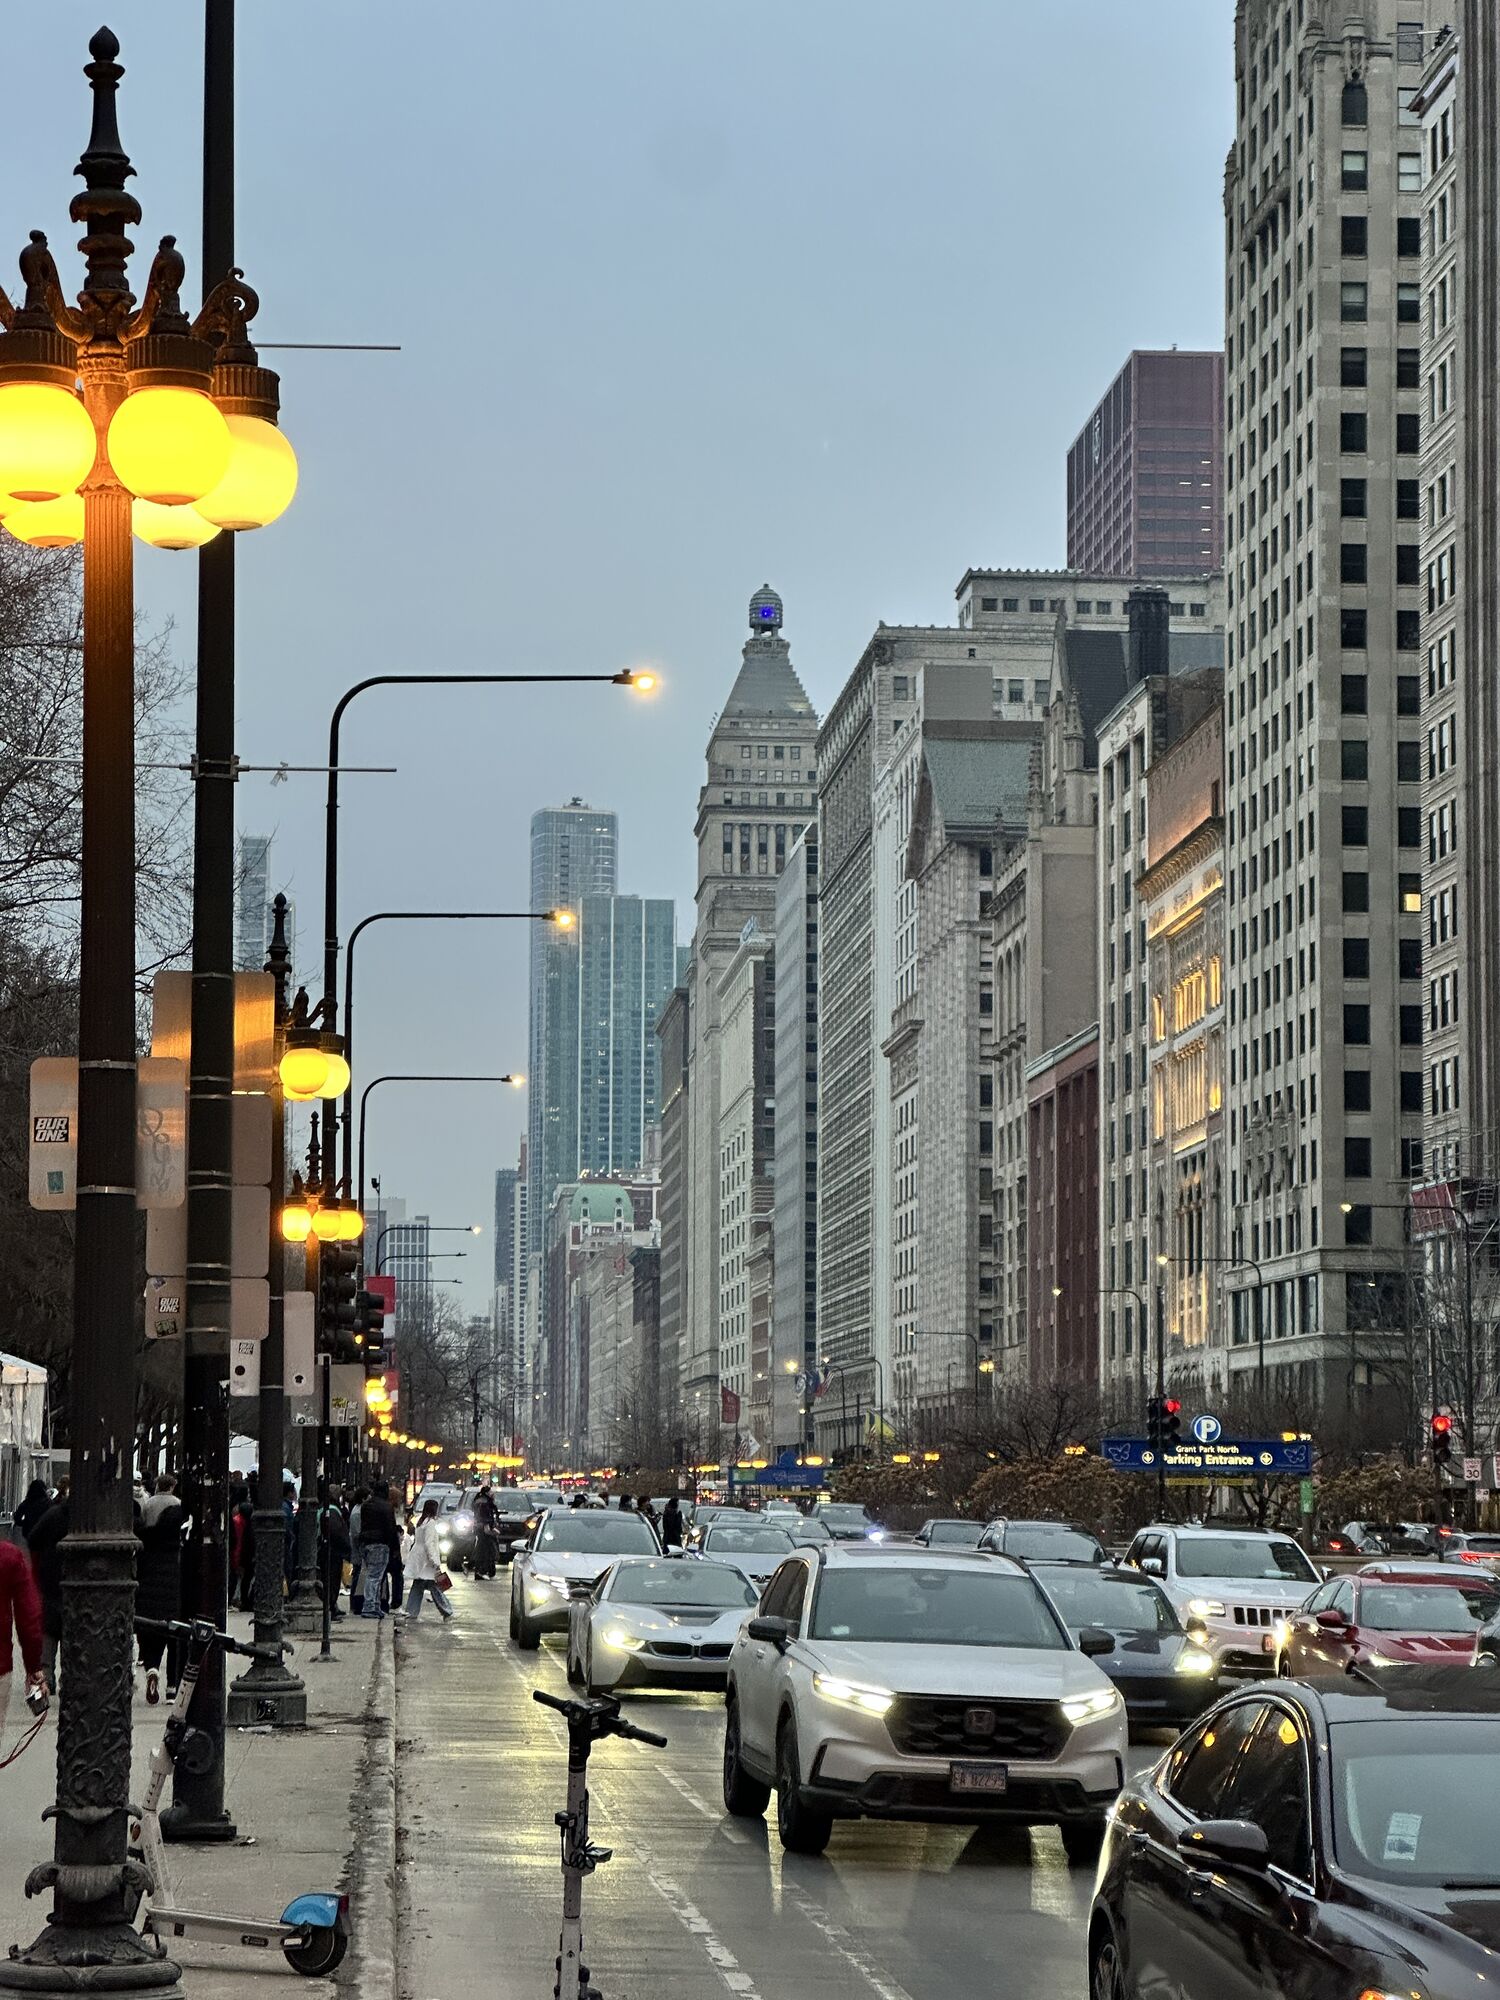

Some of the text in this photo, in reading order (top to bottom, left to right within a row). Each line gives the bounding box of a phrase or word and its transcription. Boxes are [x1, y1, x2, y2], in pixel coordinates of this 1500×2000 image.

[36, 1118, 67, 1130] BUR
[35, 1130, 67, 1141] ONE
[1201, 1419, 1217, 1442] P
[1176, 1445, 1197, 1453] Grant
[1217, 1446, 1239, 1454] North
[1205, 1454, 1254, 1465] Entrance
[1466, 1469, 1480, 1479] 30
